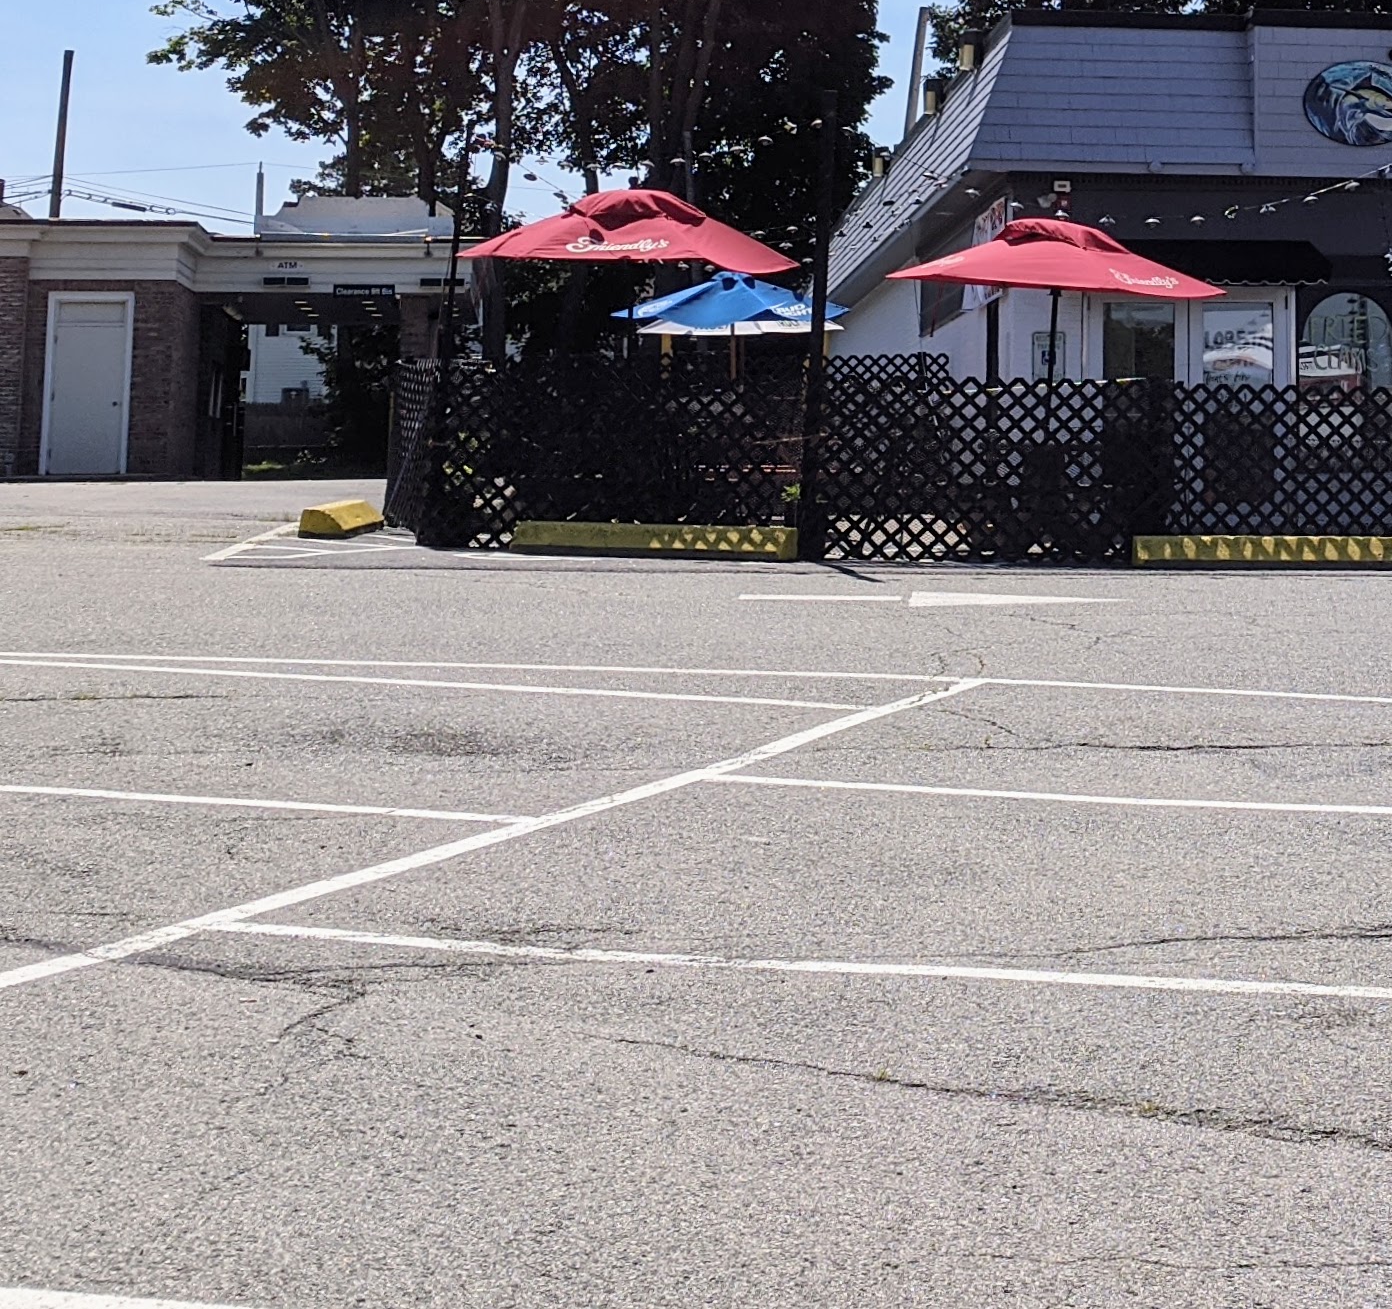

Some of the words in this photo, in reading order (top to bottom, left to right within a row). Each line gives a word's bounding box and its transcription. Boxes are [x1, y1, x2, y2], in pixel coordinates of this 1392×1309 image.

[565, 236, 670, 253] Friendly's
[277, 261, 298, 269] ATM
[336, 287, 370, 295] Clearance
[775, 303, 806, 314] BUD
